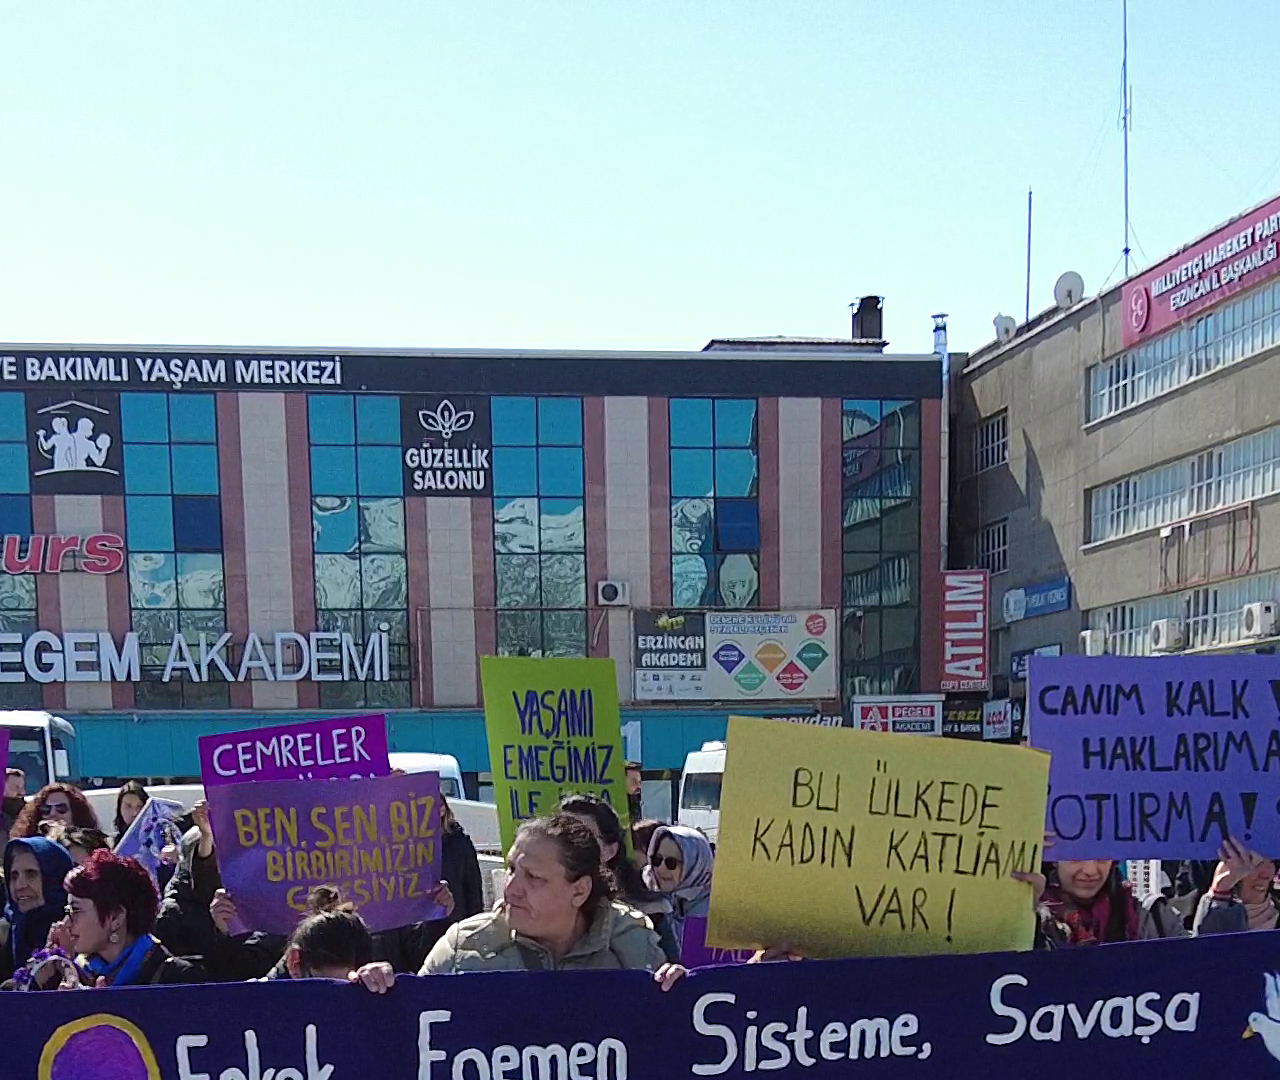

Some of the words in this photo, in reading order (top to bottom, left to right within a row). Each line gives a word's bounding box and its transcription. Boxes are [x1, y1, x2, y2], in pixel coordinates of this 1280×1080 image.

[1203, 230, 1254, 270] HAREKET
[25, 356, 130, 382] BAKIMLI
[136, 357, 226, 389] YAŞAM
[235, 355, 343, 385] MERKEZİ
[405, 443, 491, 472] GÜZELLİK
[412, 469, 486, 492] SALONU
[637, 633, 705, 650] ERZİNCAN
[944, 573, 985, 679] ATILIM
[162, 621, 391, 684] AKADEMİ
[641, 651, 703, 667] AKADEMİ
[511, 687, 595, 740] YAŞAMI
[1038, 683, 1146, 716] CANIM
[1165, 678, 1251, 720] KALK
[212, 725, 372, 777] CEMRELER
[502, 740, 615, 785] EMEĞİMİZ
[388, 792, 436, 844] BİZ
[791, 766, 841, 812] BU
[869, 759, 1004, 830] ÜLKEDE
[750, 817, 856, 868] KADIN
[690, 992, 934, 1077] Sisteme,
[985, 972, 1202, 1046] Savaşa
